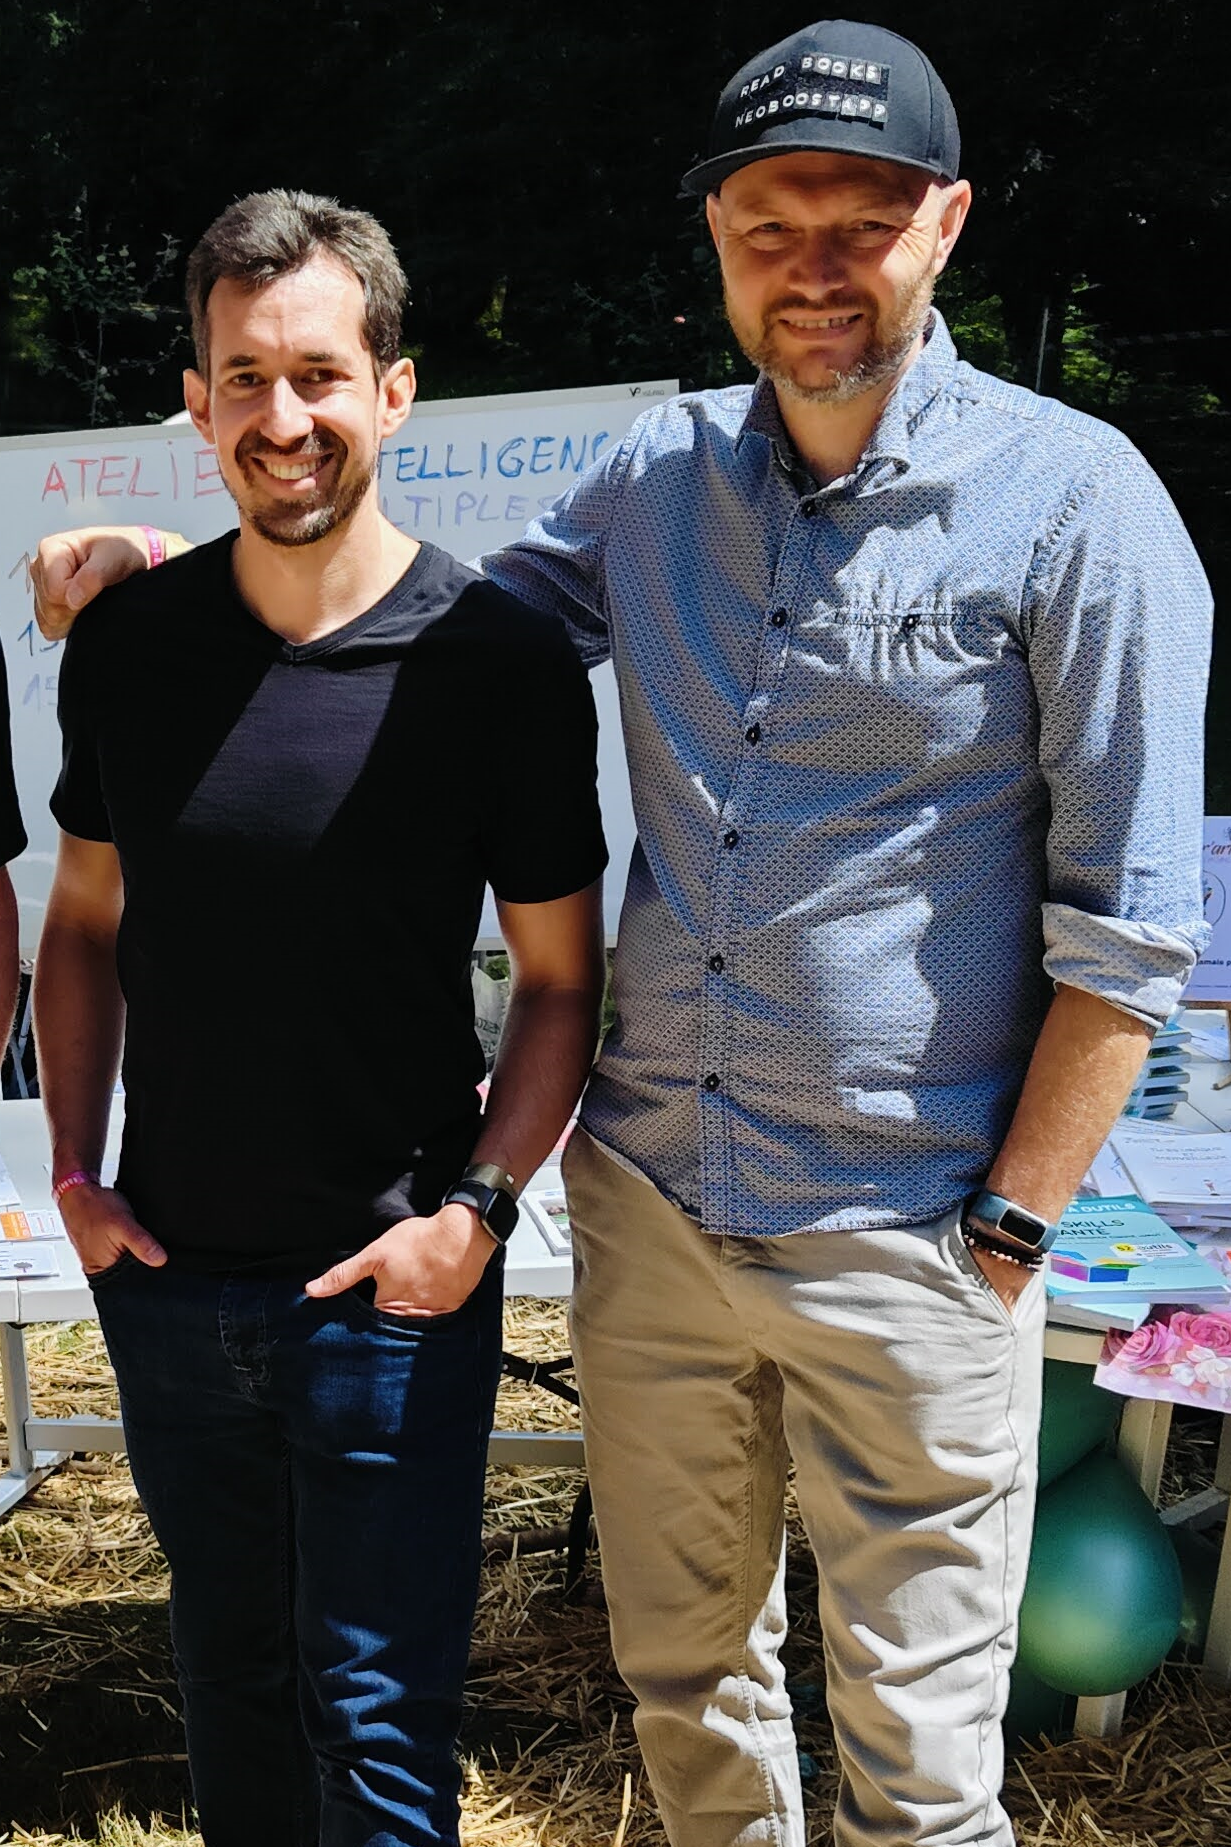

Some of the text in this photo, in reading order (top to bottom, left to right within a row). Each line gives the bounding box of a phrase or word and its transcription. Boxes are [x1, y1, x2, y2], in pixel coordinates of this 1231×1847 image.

[739, 56, 878, 98] READ BOOKS
[1081, 1202, 1136, 1213] OUTILS
[1060, 1219, 1126, 1229] SKILLS
